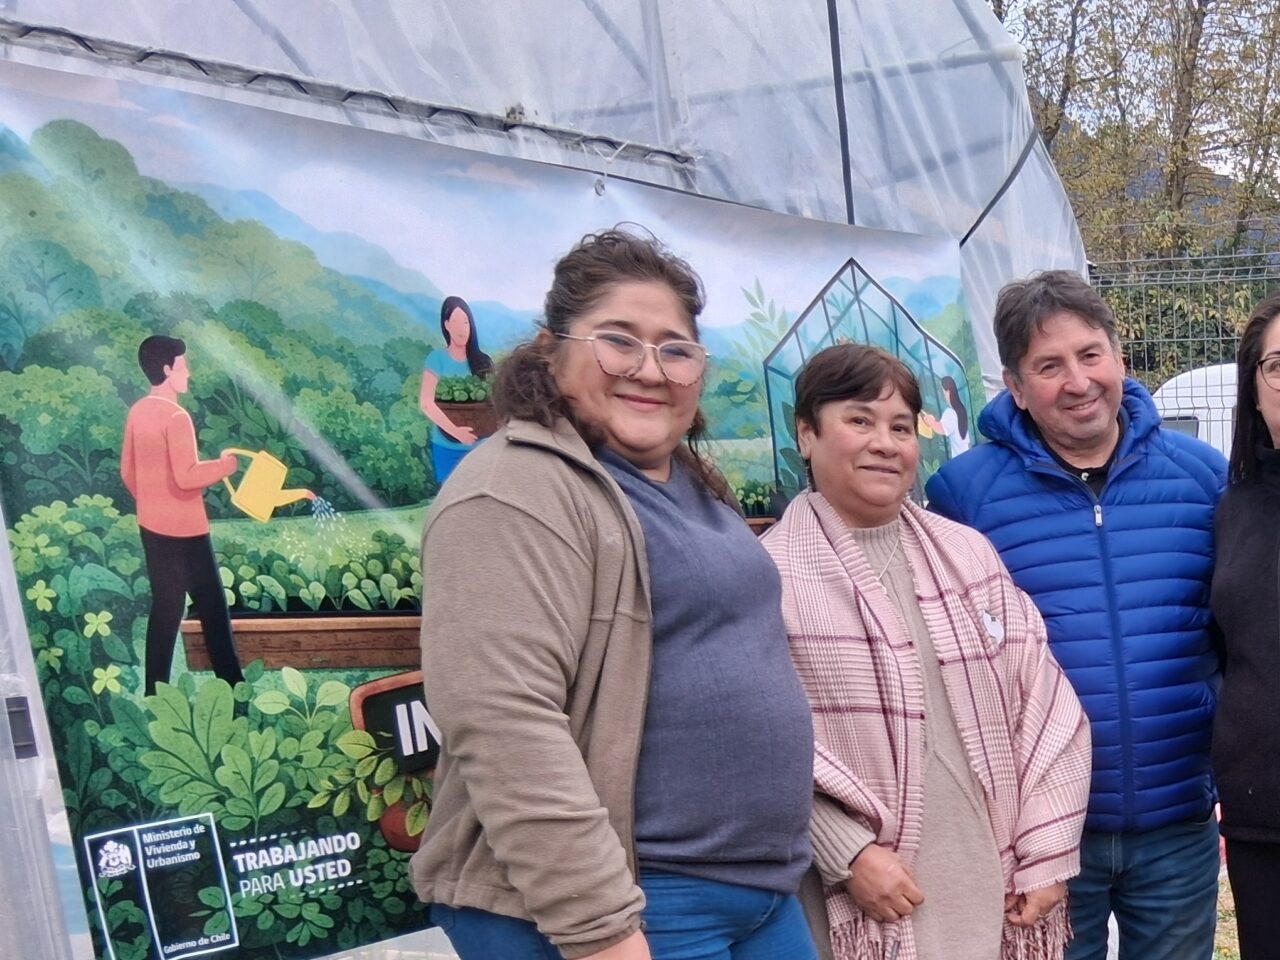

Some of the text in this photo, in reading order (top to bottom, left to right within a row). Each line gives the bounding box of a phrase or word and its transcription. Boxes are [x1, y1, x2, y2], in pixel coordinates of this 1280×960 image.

[142, 824, 206, 844] Ministerio de
[144, 839, 196, 856] Vivienda y
[233, 832, 361, 873] TRABAJANDO
[146, 852, 201, 868] Urbanismo
[240, 859, 352, 898] PARA USTED
[163, 933, 231, 954] Gobierno de Chile
